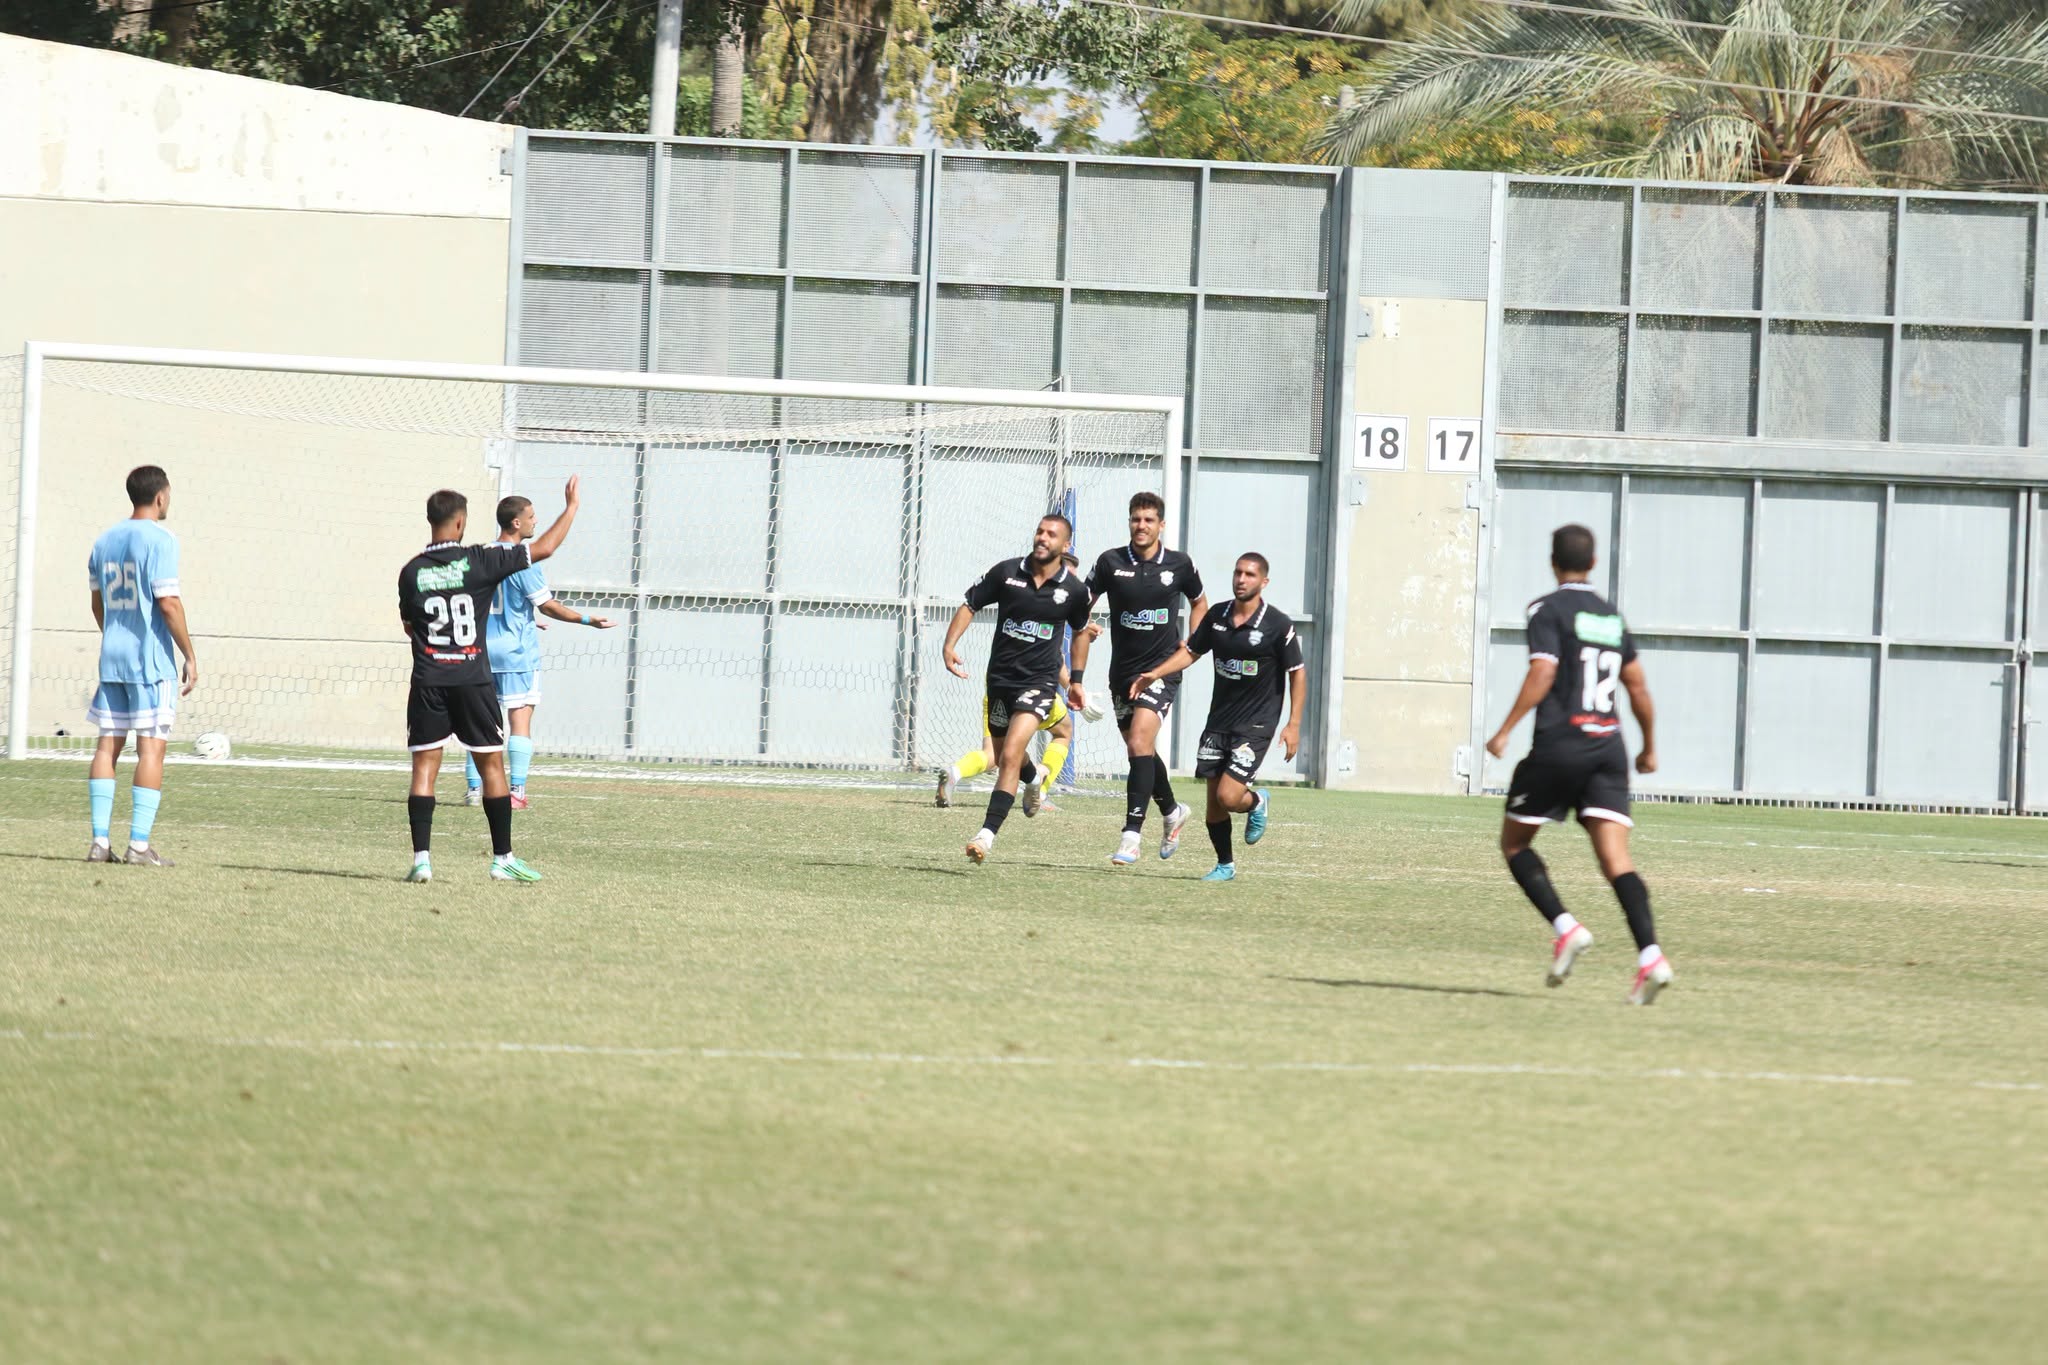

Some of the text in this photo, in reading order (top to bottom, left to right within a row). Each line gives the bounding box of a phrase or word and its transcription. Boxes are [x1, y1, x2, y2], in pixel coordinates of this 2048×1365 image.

[1361, 427, 1399, 459] 18
[1436, 430, 1474, 461] 17
[104, 562, 138, 611] 25
[424, 593, 477, 647] 28
[1579, 646, 1622, 713] 12
